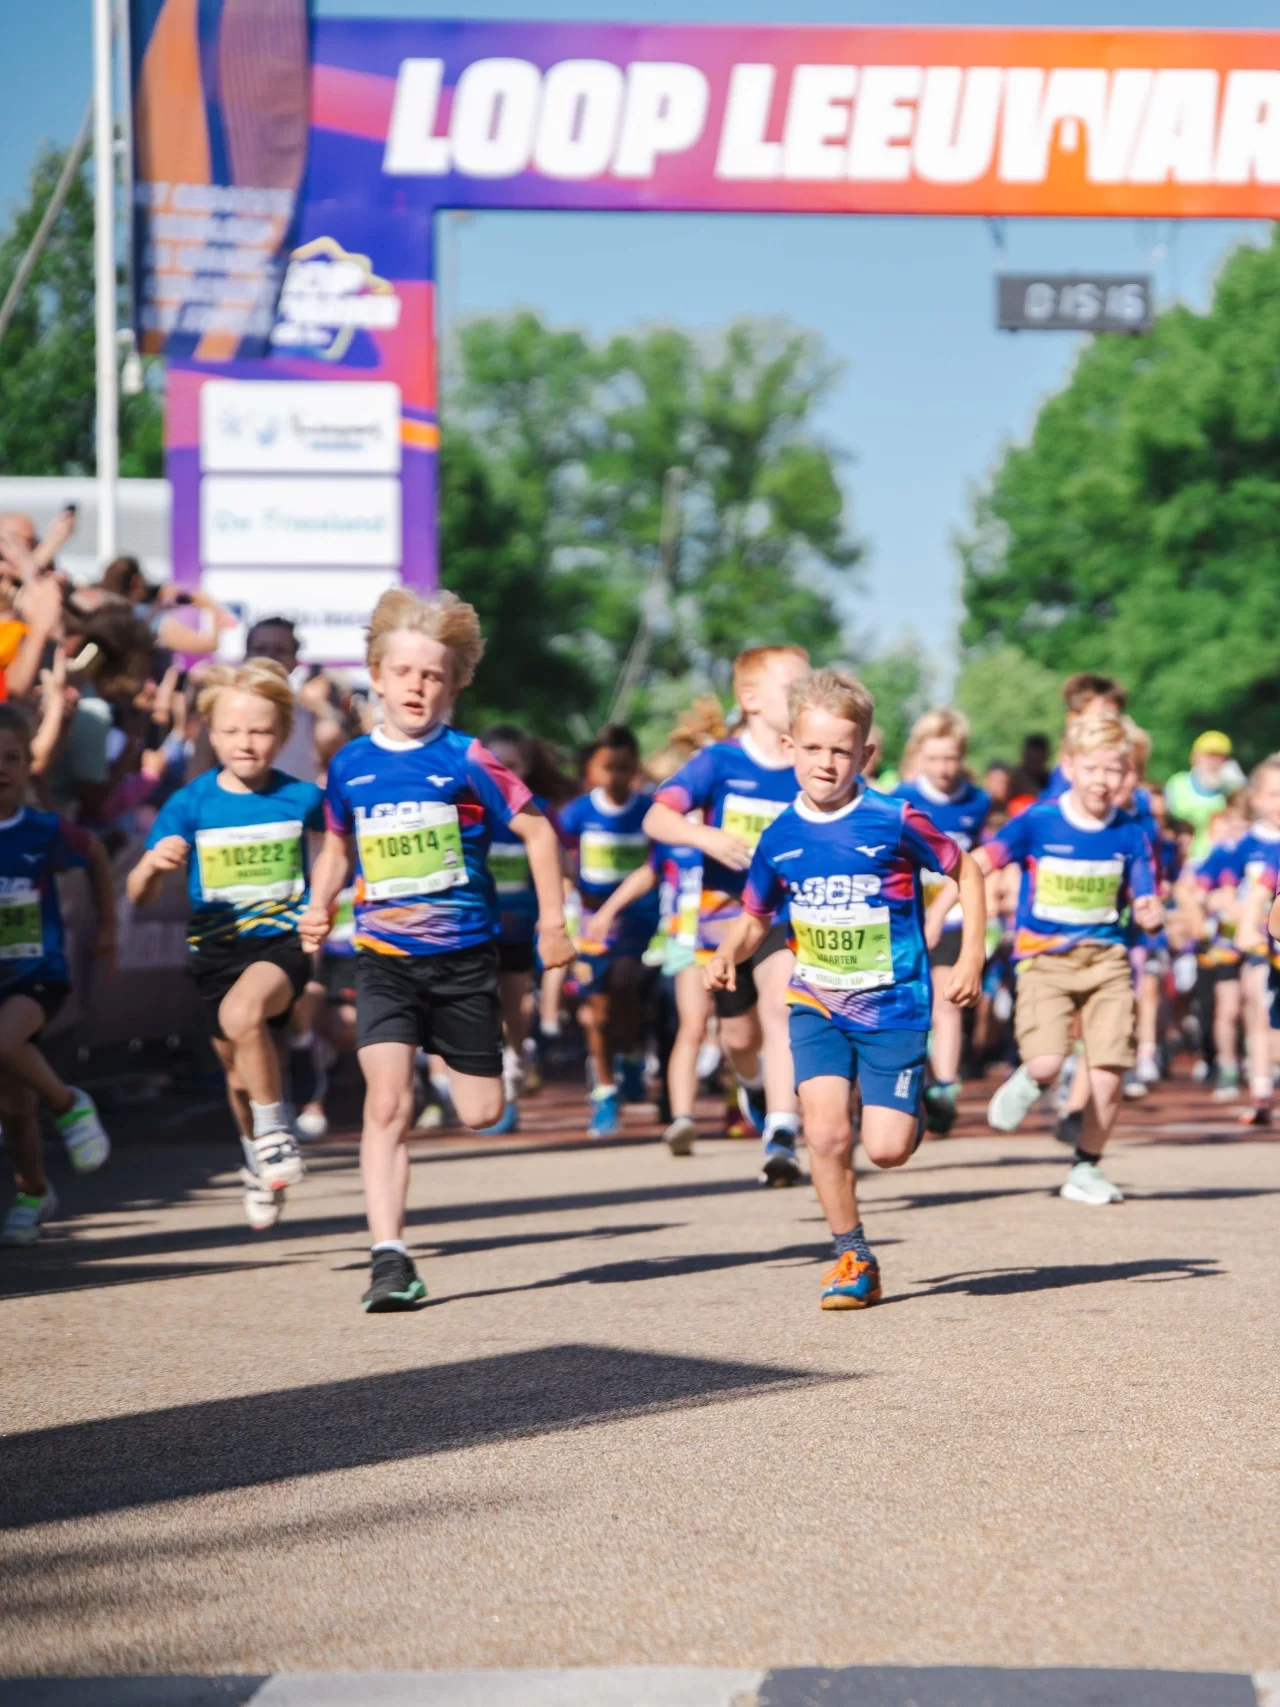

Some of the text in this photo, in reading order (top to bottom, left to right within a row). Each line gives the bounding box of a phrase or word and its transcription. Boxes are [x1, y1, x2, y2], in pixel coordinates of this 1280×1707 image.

[382, 57, 710, 181] LOOP
[218, 843, 285, 867] 10222
[376, 830, 440, 858] 10814
[807, 927, 866, 951] 10387
